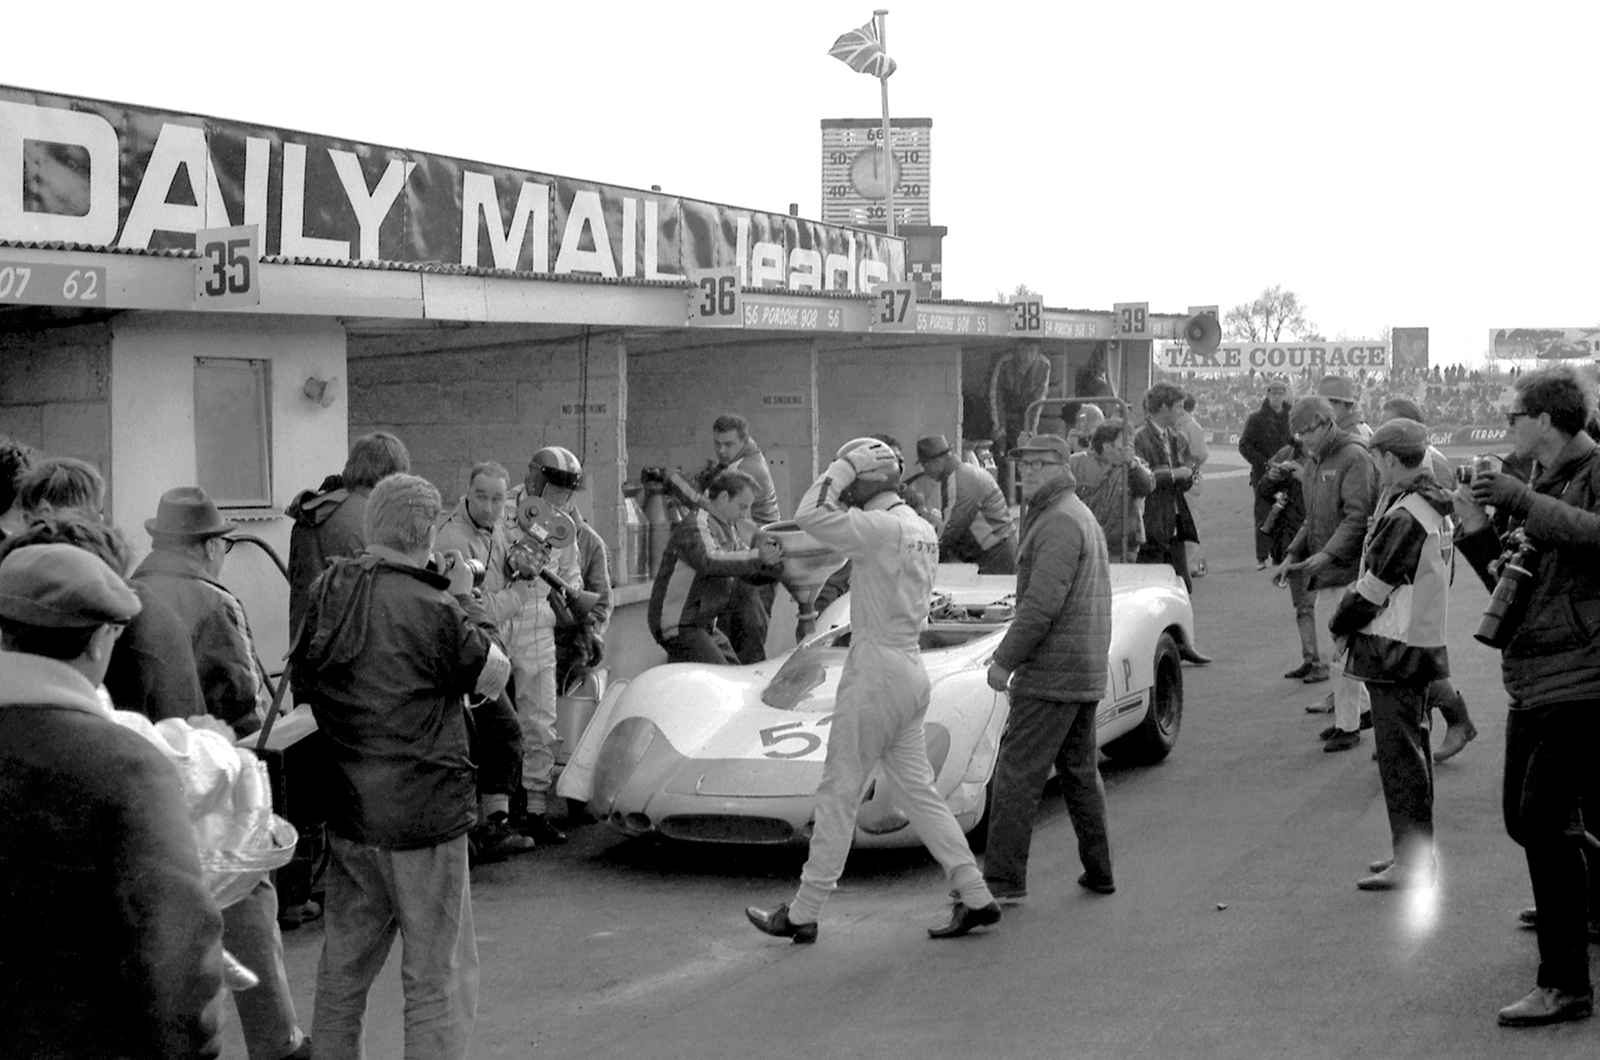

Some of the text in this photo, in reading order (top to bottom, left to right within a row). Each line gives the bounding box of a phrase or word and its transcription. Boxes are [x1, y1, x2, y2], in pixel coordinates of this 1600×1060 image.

[830, 153, 847, 165] 50
[905, 151, 919, 163] 10
[0, 101, 417, 260] DAILY
[461, 170, 687, 281] MAIL
[829, 185, 846, 197] 40
[904, 184, 920, 197] 20
[867, 207, 884, 219] 30
[205, 239, 251, 297] 35
[63, 270, 98, 301] 62
[700, 276, 736, 317] 36
[745, 305, 840, 329] 56 PORSCHE 908 56
[881, 289, 912, 324] 37
[1015, 302, 1040, 331] 38
[917, 314, 927, 331] 55
[977, 316, 987, 332] 55
[1122, 308, 1145, 333] 39
[1166, 346, 1386, 368] TAKE COURAGE
[562, 404, 573, 415] NO
[773, 395, 803, 405] SMOKING
[1430, 432, 1452, 445] Gulf
[1122, 658, 1131, 692] P
[759, 713, 834, 759] 5
